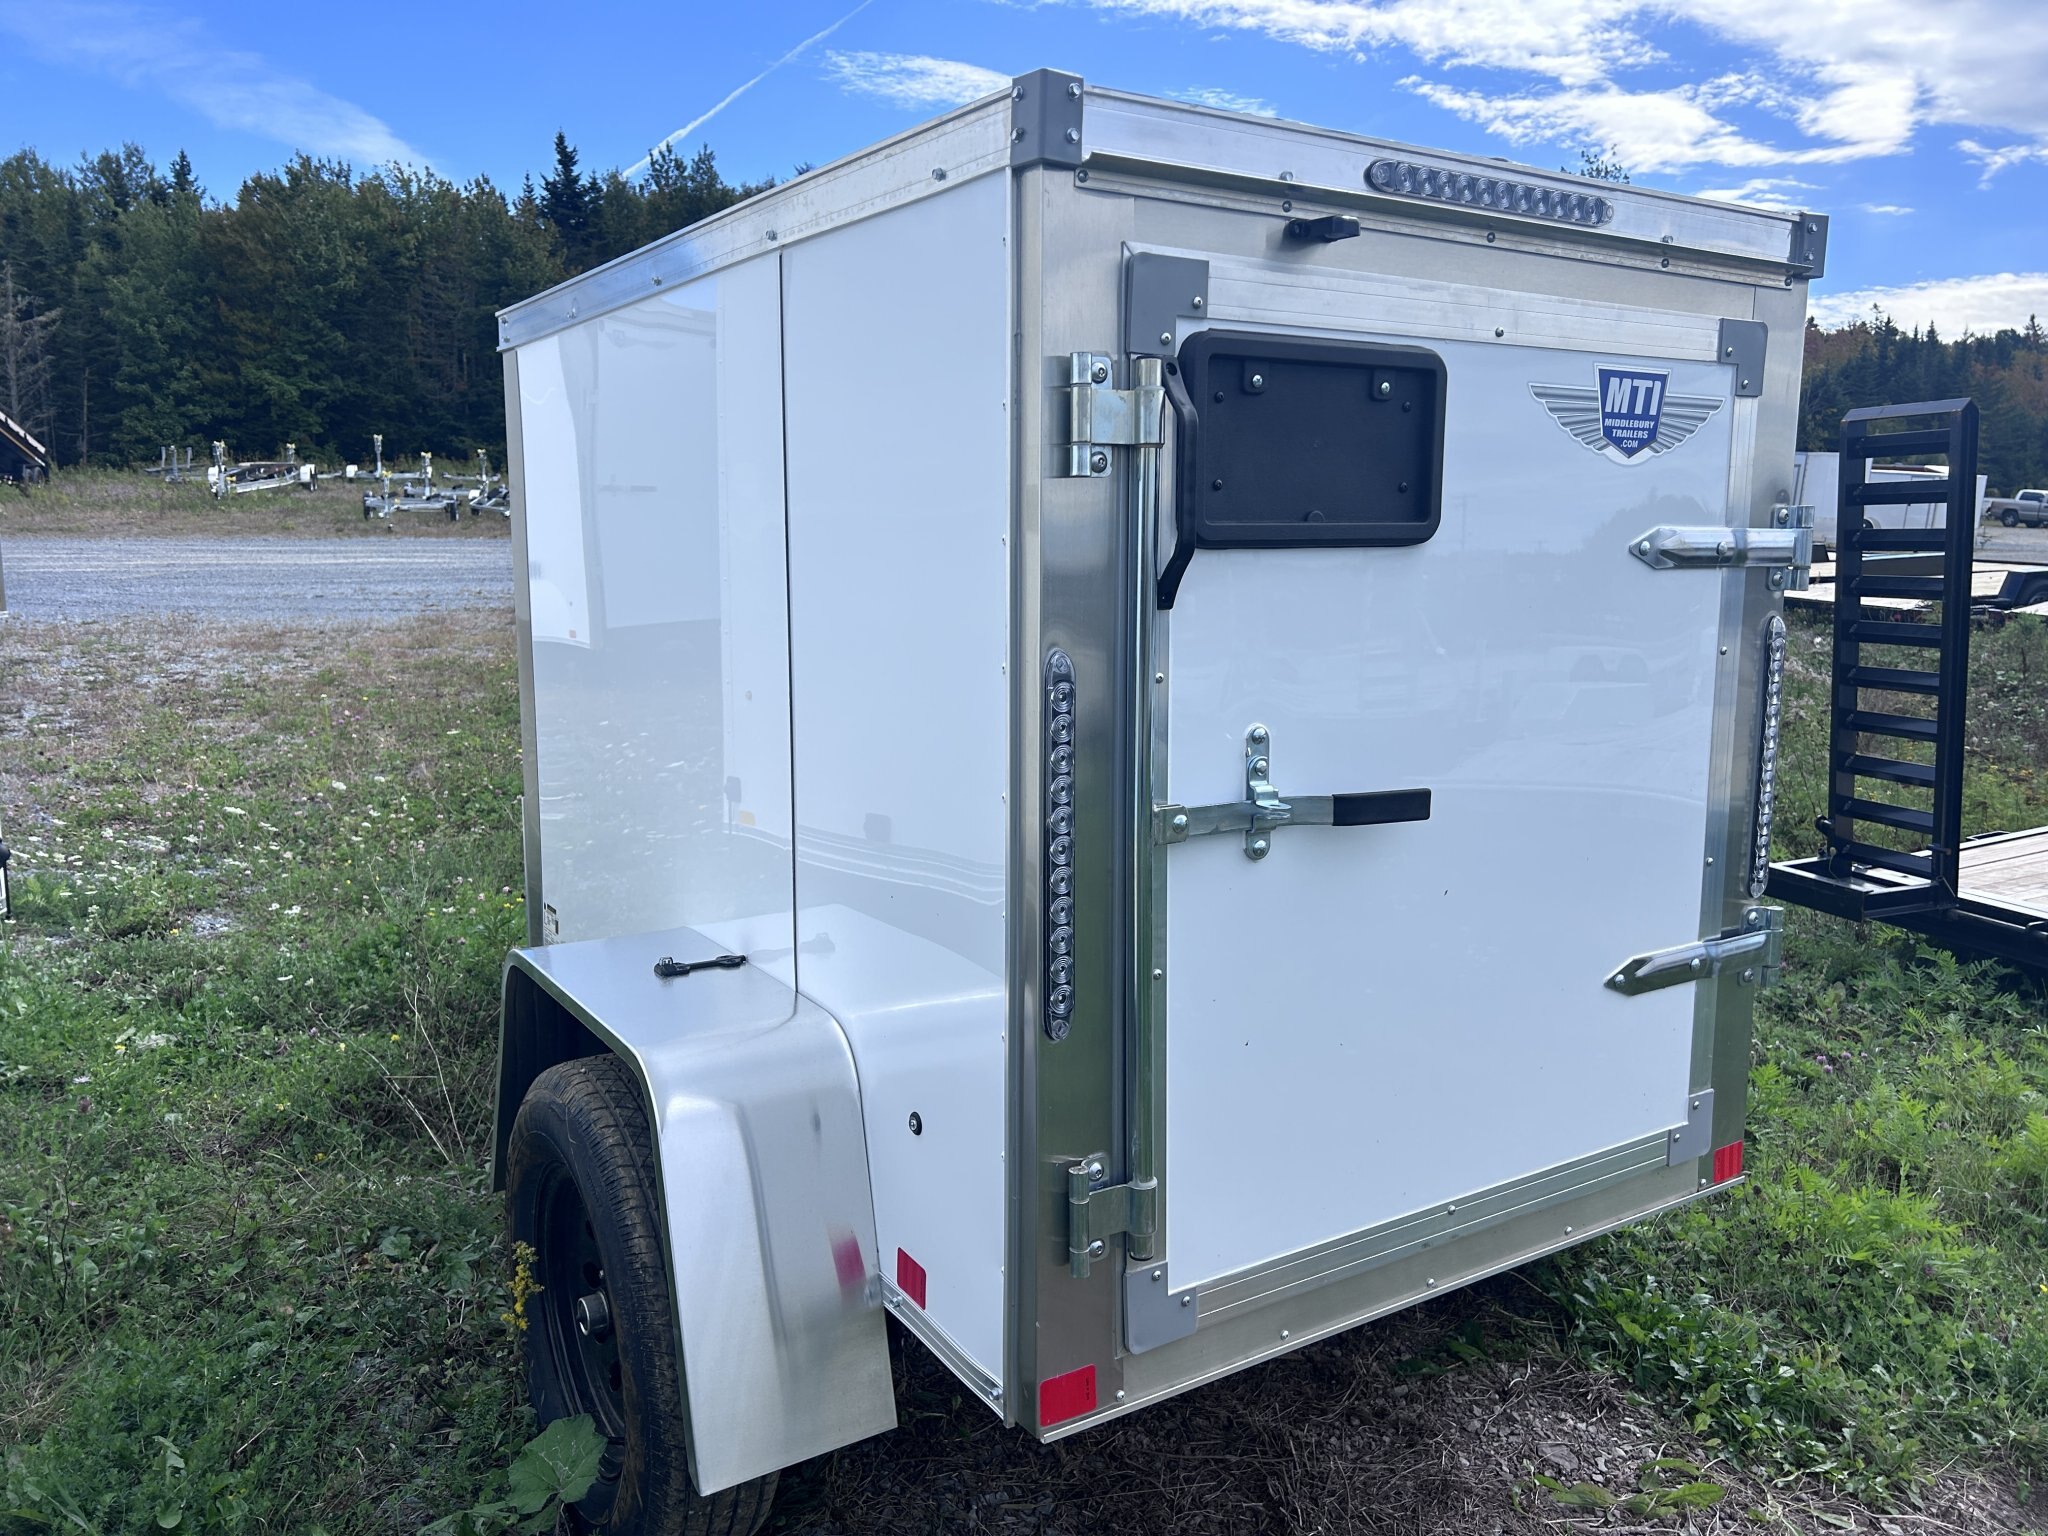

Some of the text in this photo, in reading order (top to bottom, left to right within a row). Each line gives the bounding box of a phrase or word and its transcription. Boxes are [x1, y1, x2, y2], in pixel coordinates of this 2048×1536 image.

[1605, 377, 1662, 416] MTI
[1604, 418, 1655, 429] MIDDLEBURY
[1612, 429, 1648, 439] TRAILERS
[1620, 440, 1638, 448] .COM
